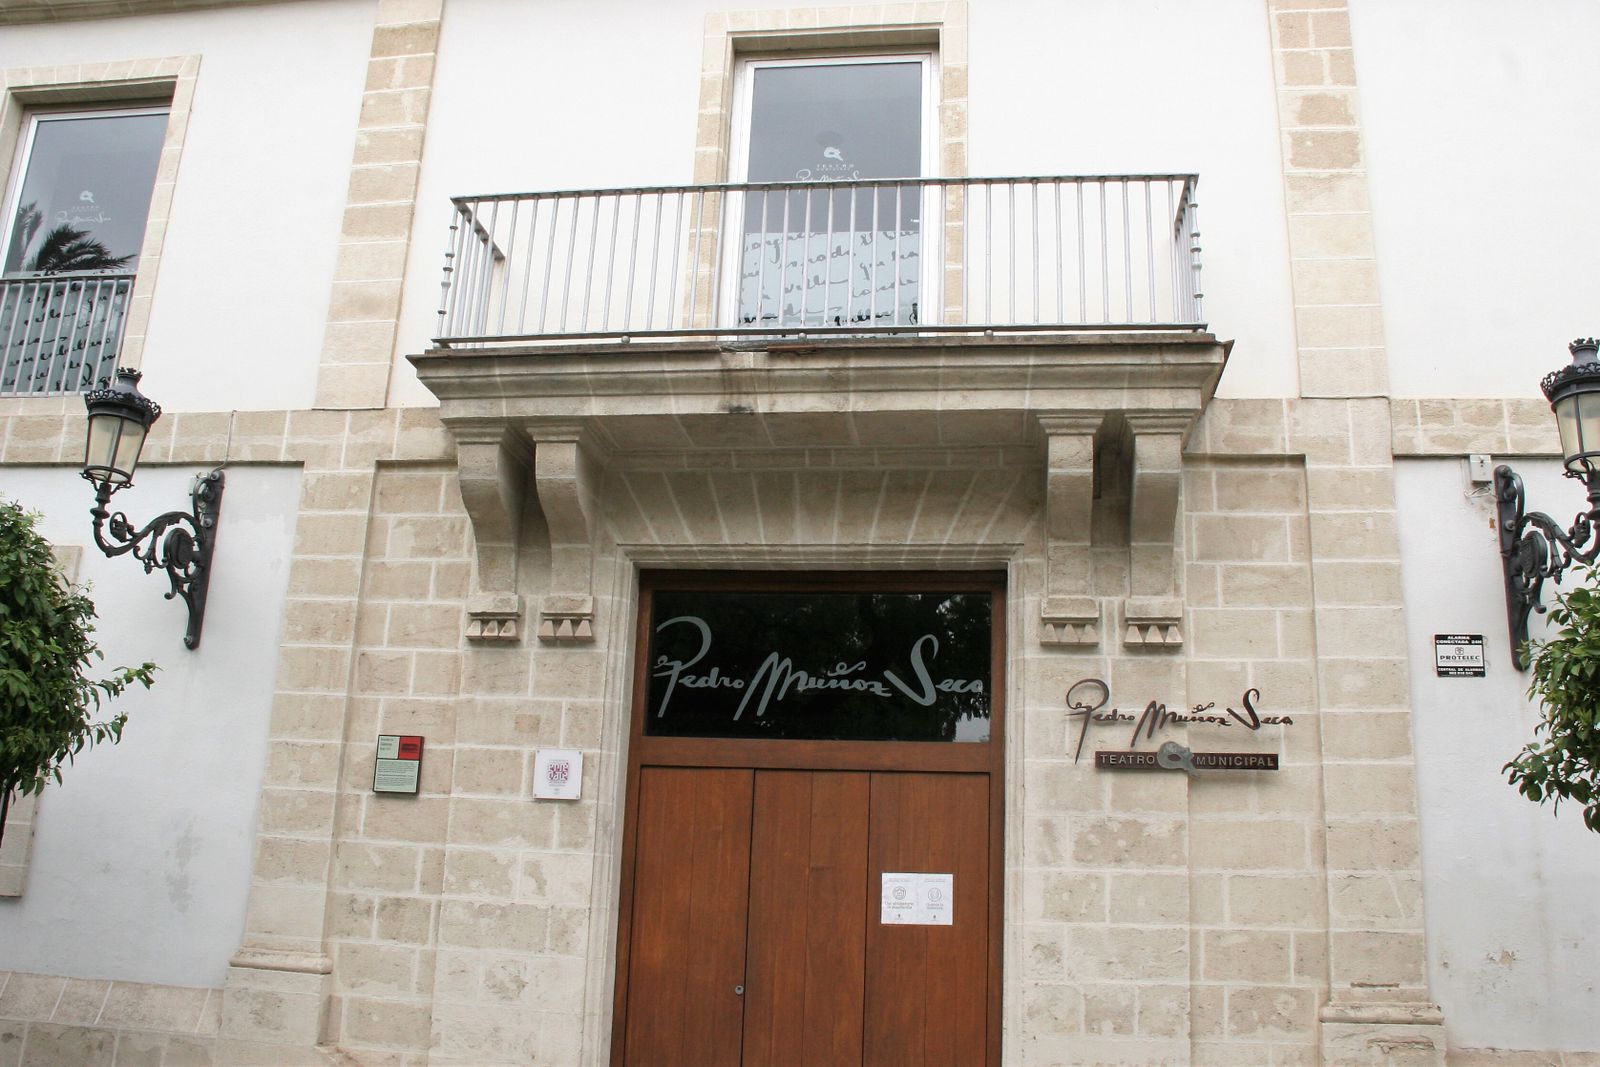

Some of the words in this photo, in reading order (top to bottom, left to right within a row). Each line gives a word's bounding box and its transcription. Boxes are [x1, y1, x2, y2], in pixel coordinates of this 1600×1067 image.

[653, 615, 745, 719] Pedro
[732, 651, 893, 721] Muñoz
[883, 634, 983, 706] Seca
[1065, 678, 1135, 765] Pedro
[1130, 700, 1232, 748] Muñoz
[1226, 688, 1294, 731] Seca
[1100, 753, 1156, 765] TEATRO
[1196, 754, 1275, 768] MUNICIPAL
